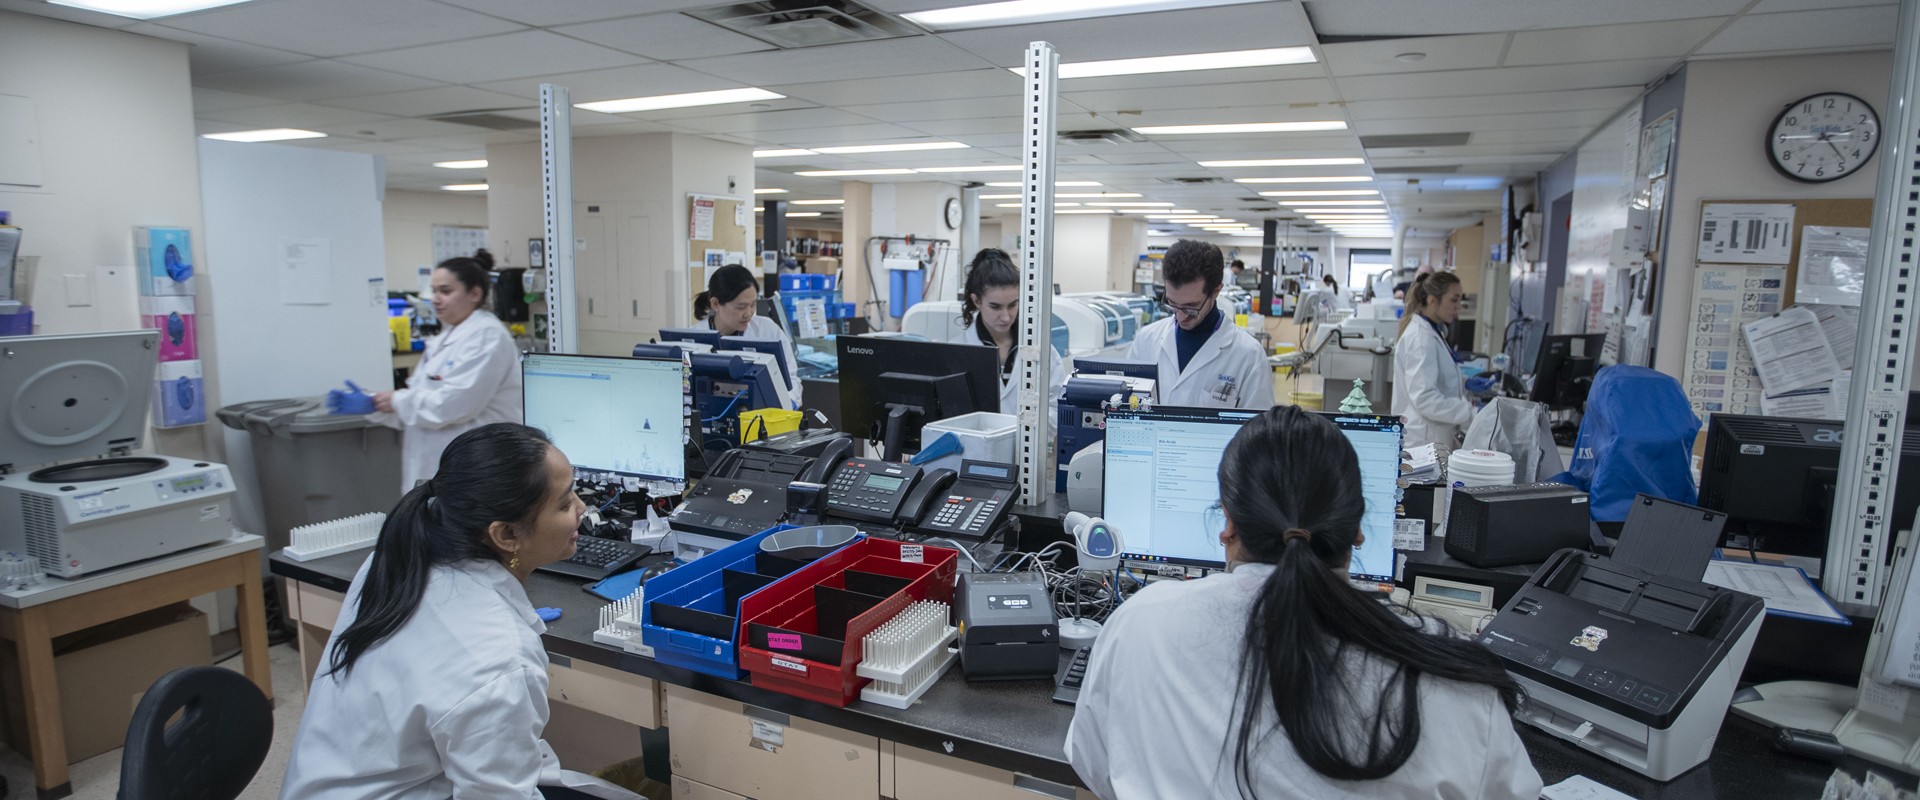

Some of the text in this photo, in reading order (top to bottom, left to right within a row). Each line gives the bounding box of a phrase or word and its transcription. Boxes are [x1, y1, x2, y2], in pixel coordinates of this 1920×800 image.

[1803, 103, 1812, 114] 11
[1823, 98, 1835, 109] 12
[1847, 102, 1852, 112] 1
[1785, 116, 1797, 127] 10
[1859, 114, 1868, 125] 2
[1810, 125, 1841, 133] SickKids
[1779, 133, 1787, 144] 9
[1862, 131, 1871, 142] 3
[1782, 150, 1791, 161] 8
[1851, 148, 1860, 159] 4
[1797, 163, 1805, 173] 7
[1815, 167, 1824, 177] 6
[1837, 162, 1845, 173] 5
[847, 345, 874, 355] Lenovo
[81, 507, 114, 518] Centrifuge
[1490, 630, 1515, 643] Panasonic
[778, 661, 798, 669] STAT
